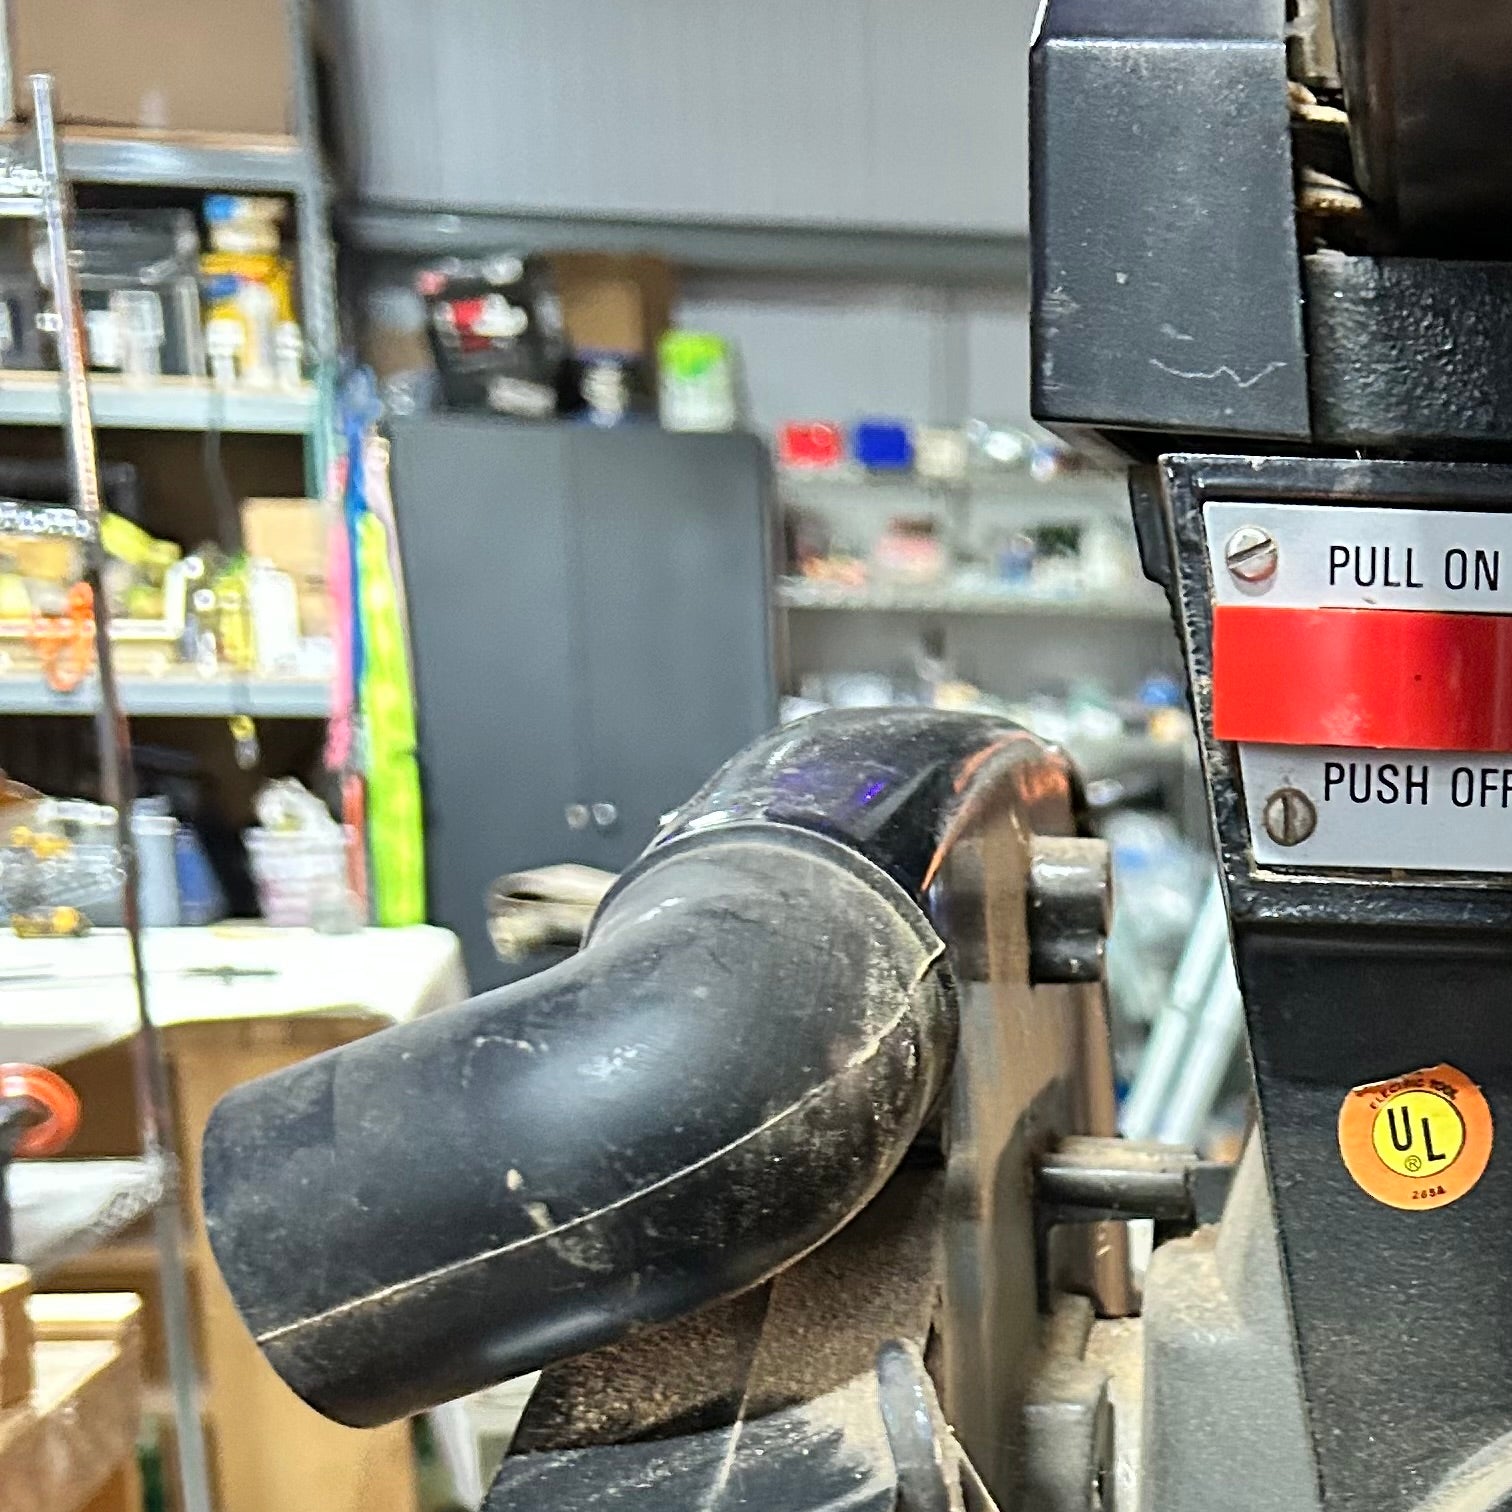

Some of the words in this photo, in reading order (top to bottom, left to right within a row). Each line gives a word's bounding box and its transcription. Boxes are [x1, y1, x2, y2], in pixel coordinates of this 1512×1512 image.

[1329, 545, 1424, 588] PULL
[1444, 548, 1499, 591] ON
[1324, 762, 1429, 805] PUSH
[1387, 1106, 1446, 1161] UL
